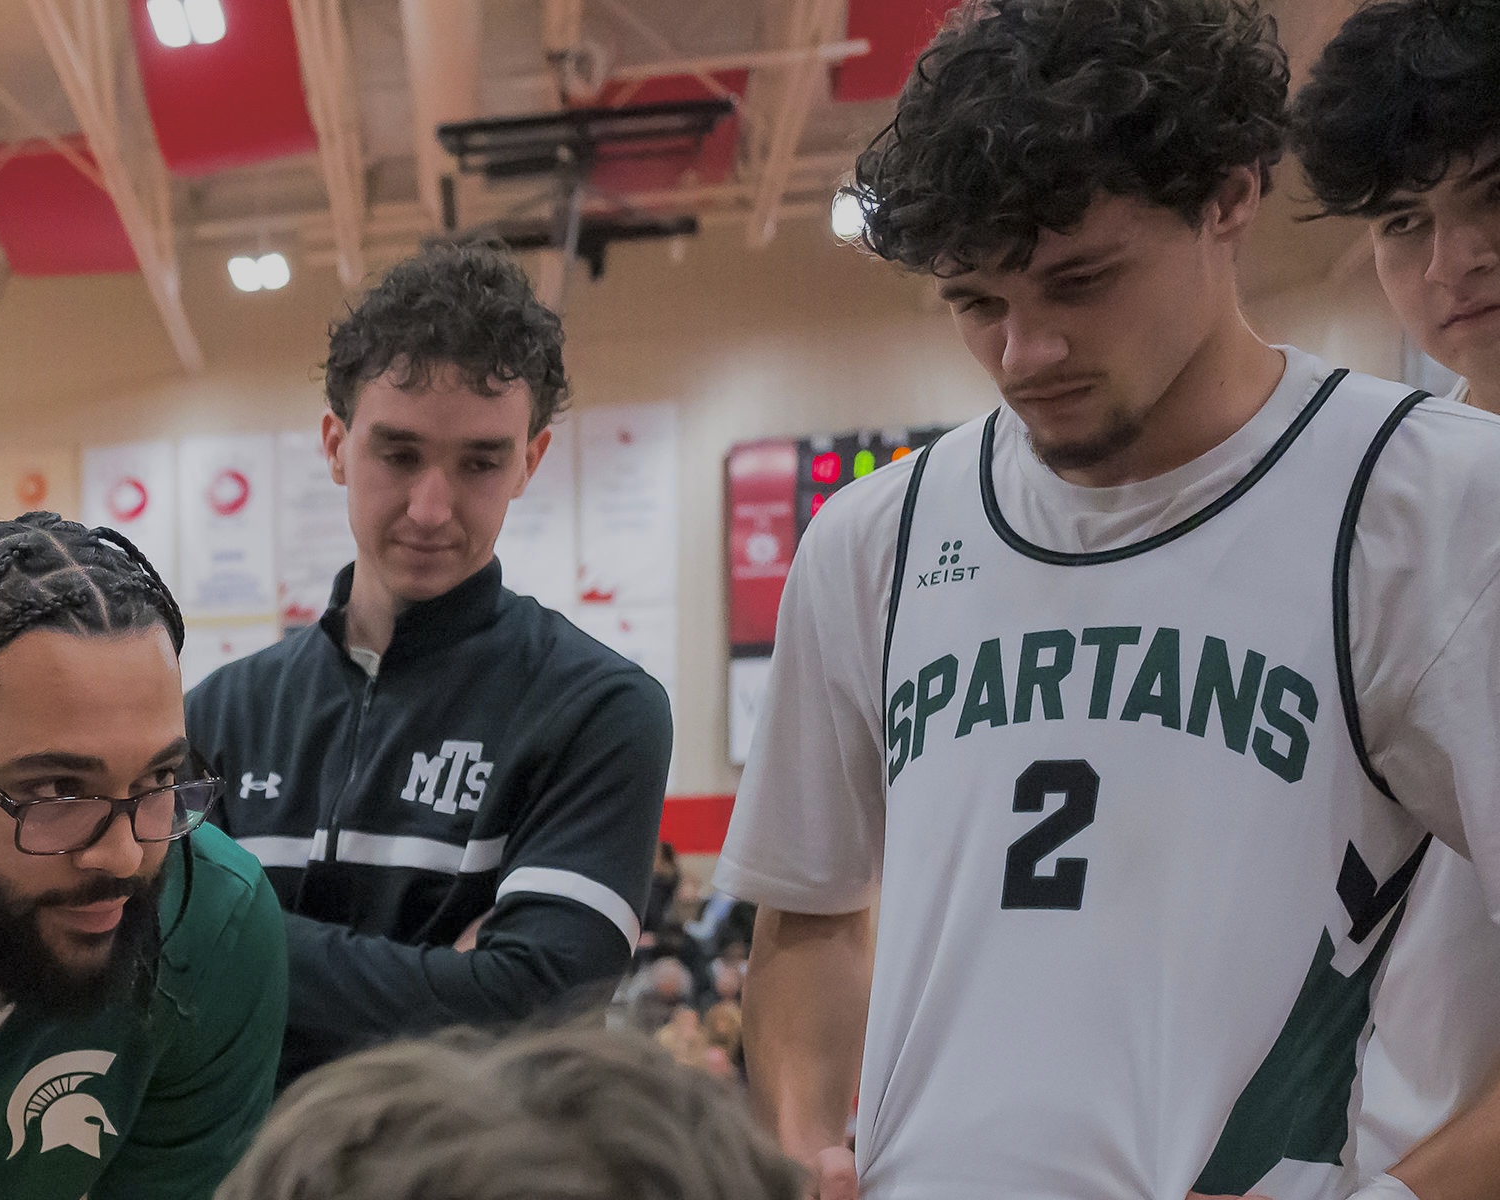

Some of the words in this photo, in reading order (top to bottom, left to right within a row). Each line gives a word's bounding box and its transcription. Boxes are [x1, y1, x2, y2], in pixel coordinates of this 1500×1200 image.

[916, 566, 980, 589] XEIST
[887, 625, 1319, 787] SPARTANS
[400, 740, 494, 815] MTS
[1000, 759, 1101, 911] 2
